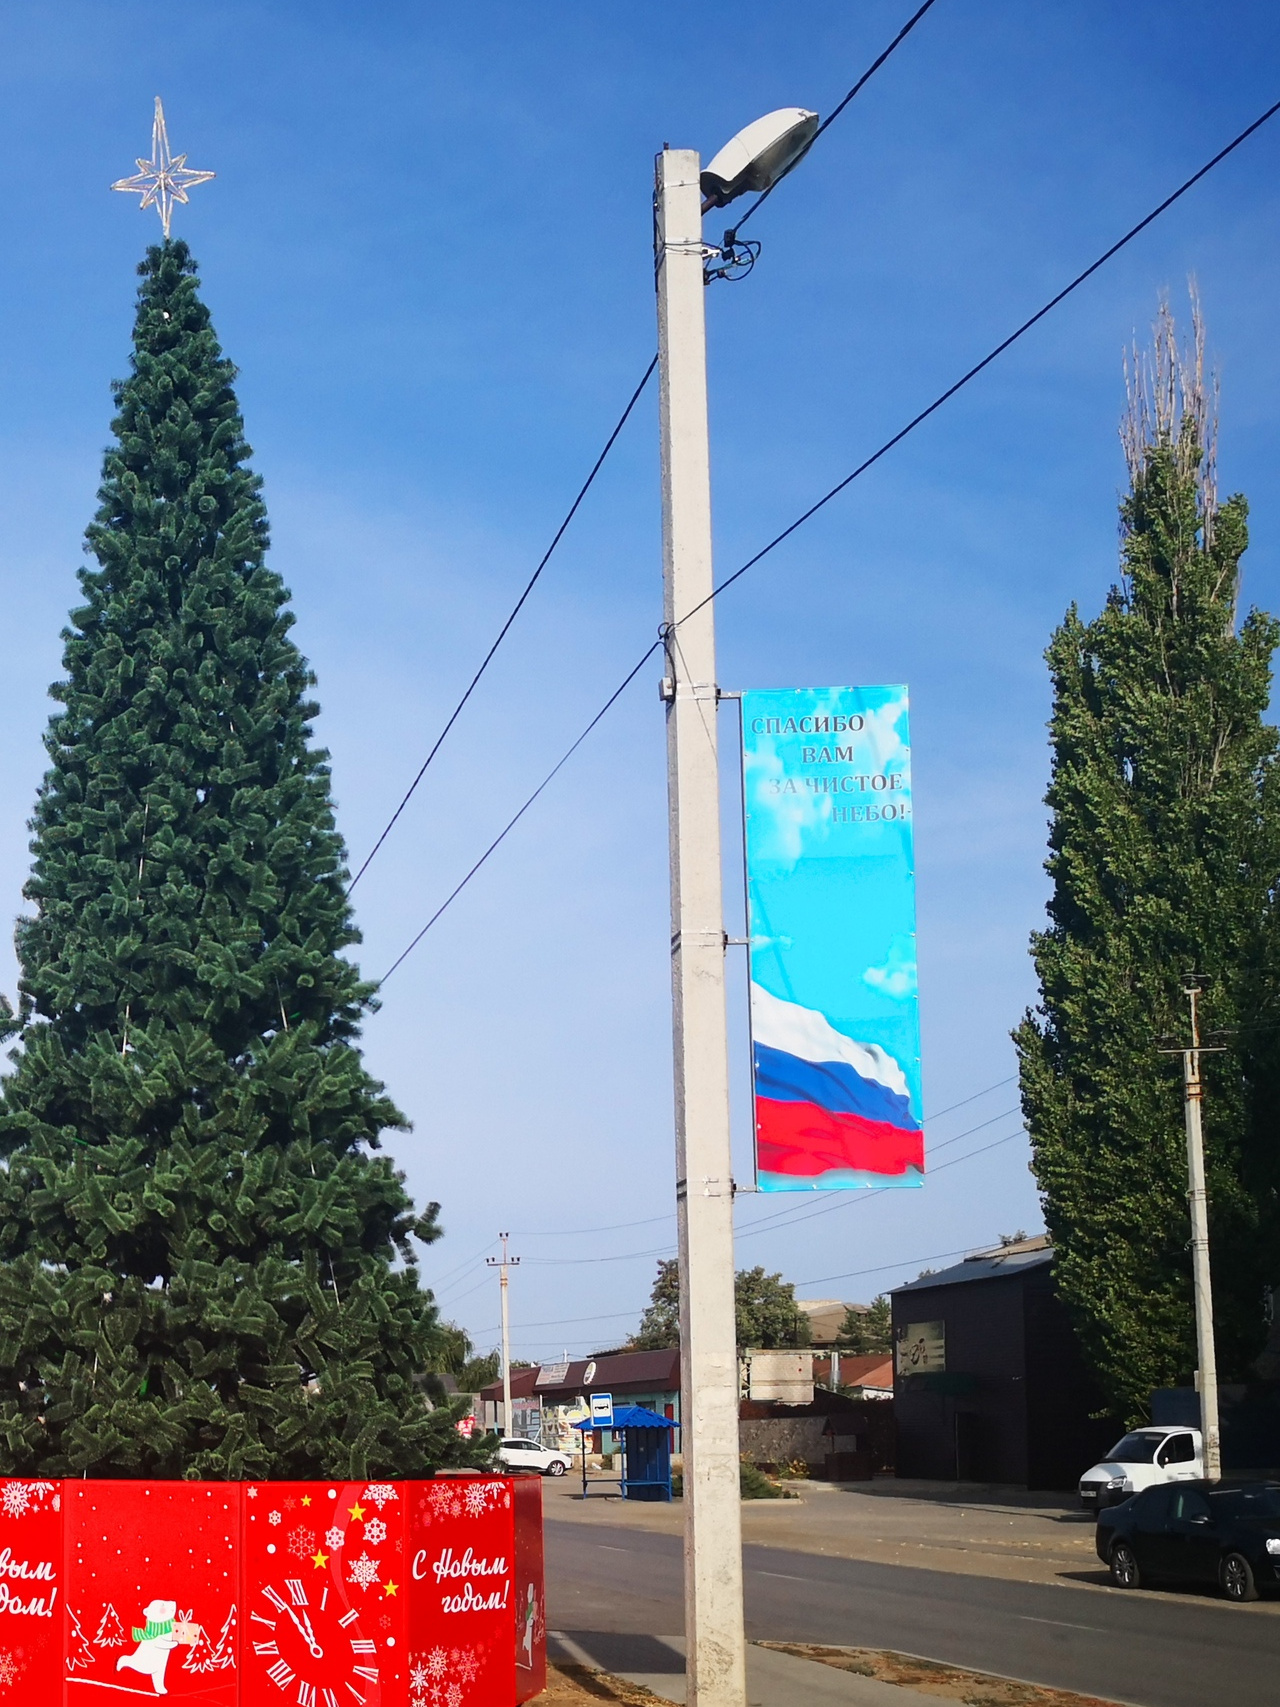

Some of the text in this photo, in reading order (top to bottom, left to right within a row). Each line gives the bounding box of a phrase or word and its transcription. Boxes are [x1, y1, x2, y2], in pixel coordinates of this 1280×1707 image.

[751, 714, 864, 734] СПАСИБО
[801, 746, 854, 763] ВАМ
[768, 773, 902, 794] ЗА ЧИСТОЕ
[832, 804, 905, 822] НЕБО!
[412, 1547, 509, 1584] С Новым
[441, 1580, 510, 1613] годом!
